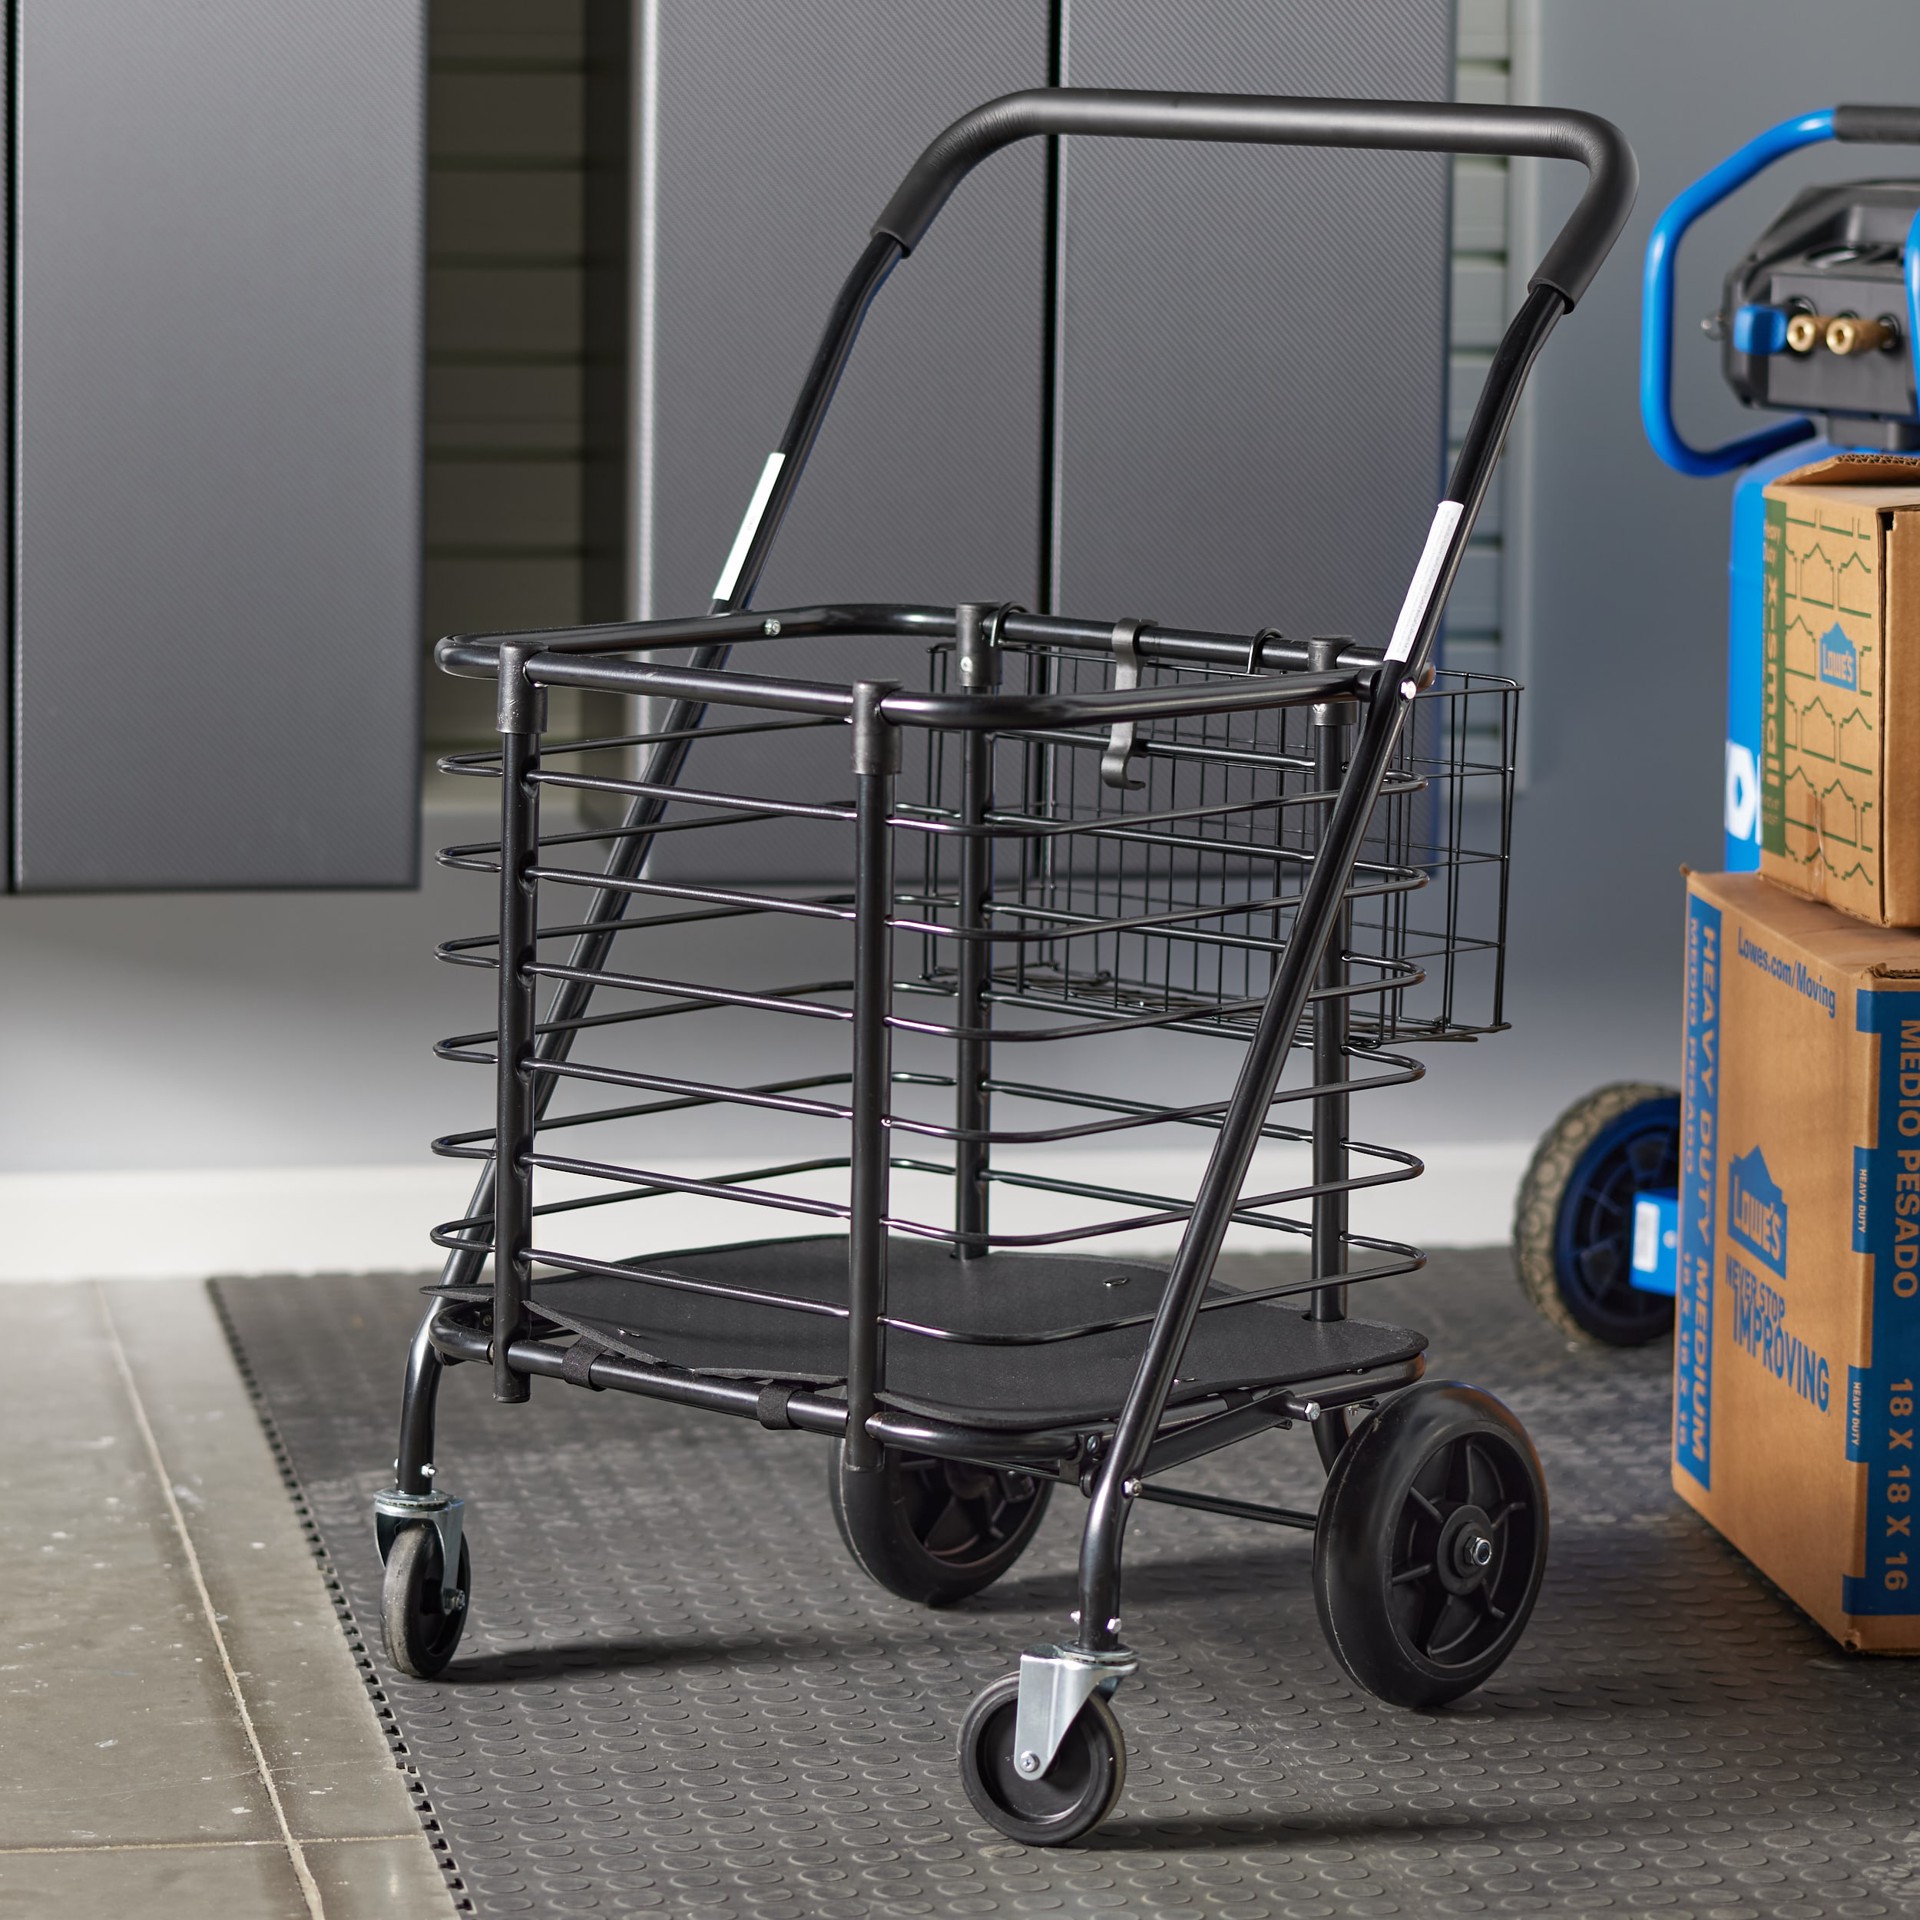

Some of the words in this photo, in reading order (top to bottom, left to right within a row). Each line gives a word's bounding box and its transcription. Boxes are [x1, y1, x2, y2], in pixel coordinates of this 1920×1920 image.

[1689, 917, 1699, 1027] MEDIO
[1737, 926, 1836, 1019] Lowes.com/Moving
[1701, 925, 1716, 1098] HEAVY
[1897, 1019, 1920, 1138] MEDIO
[1698, 1108, 1713, 1246] DUTY
[1858, 1168, 1868, 1203] HEAVY
[1733, 1174, 1782, 1263] LOWE'S
[1857, 1204, 1867, 1233] DUTY
[1892, 1149, 1920, 1299] PESADO
[1726, 1253, 1757, 1308] NEVER
[1759, 1282, 1786, 1327] STOP
[1693, 1256, 1709, 1462] MEDIUM
[1733, 1285, 1830, 1414] IMPROVING
[1851, 1417, 1861, 1447] DUTY
[1852, 1381, 1862, 1416] HEAVY
[1889, 1378, 1914, 1417] 18
[1888, 1428, 1914, 1450] X
[1886, 1464, 1911, 1504] 18
[1886, 1514, 1911, 1537] X
[1884, 1552, 1908, 1591] 16
